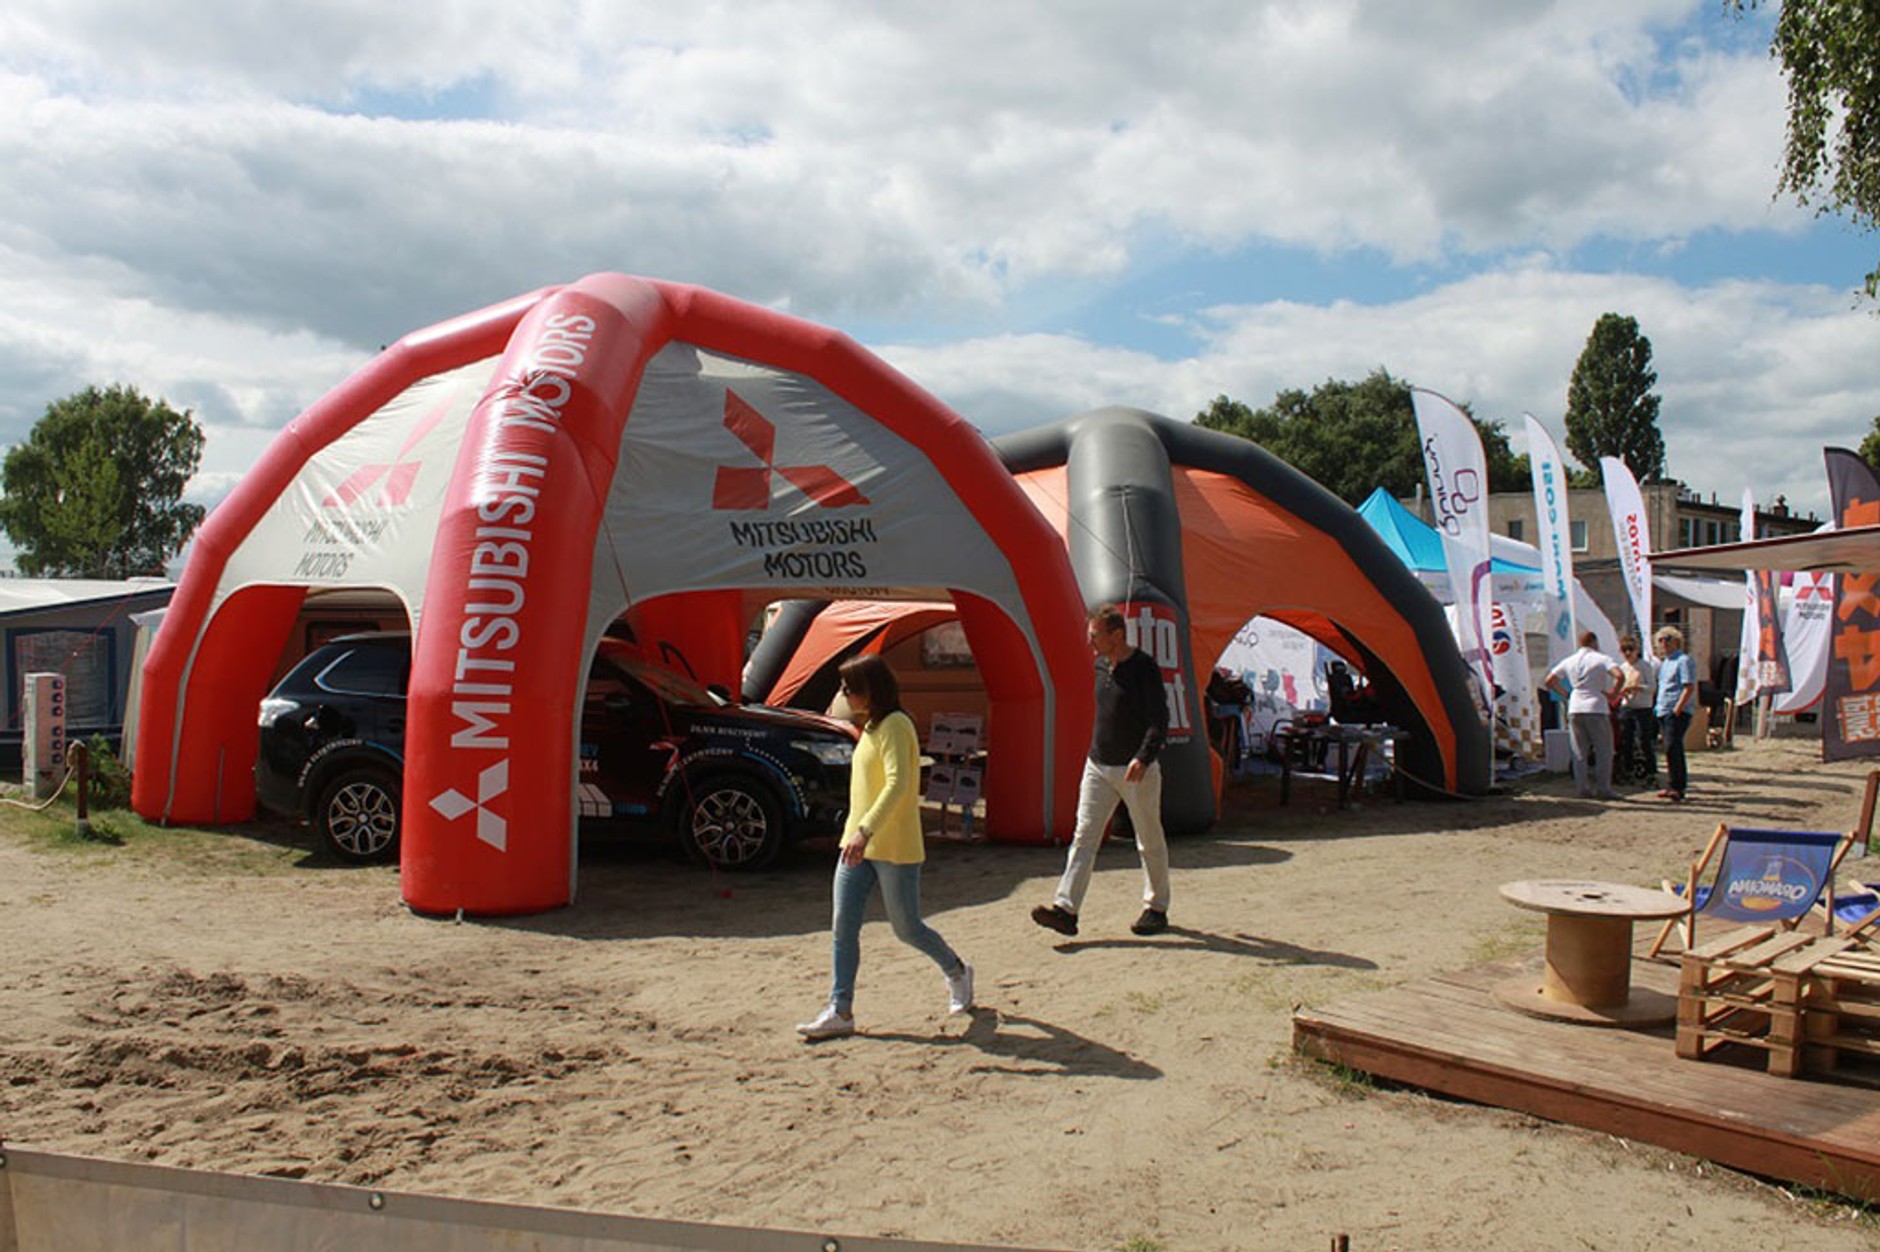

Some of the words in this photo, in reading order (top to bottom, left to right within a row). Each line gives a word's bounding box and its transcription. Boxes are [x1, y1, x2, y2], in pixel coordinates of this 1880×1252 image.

[451, 452, 548, 748] MITSUBISHI
[501, 313, 596, 433] MOTORS
[730, 519, 877, 548] MITSUBISHI
[764, 551, 867, 578] MOTORS
